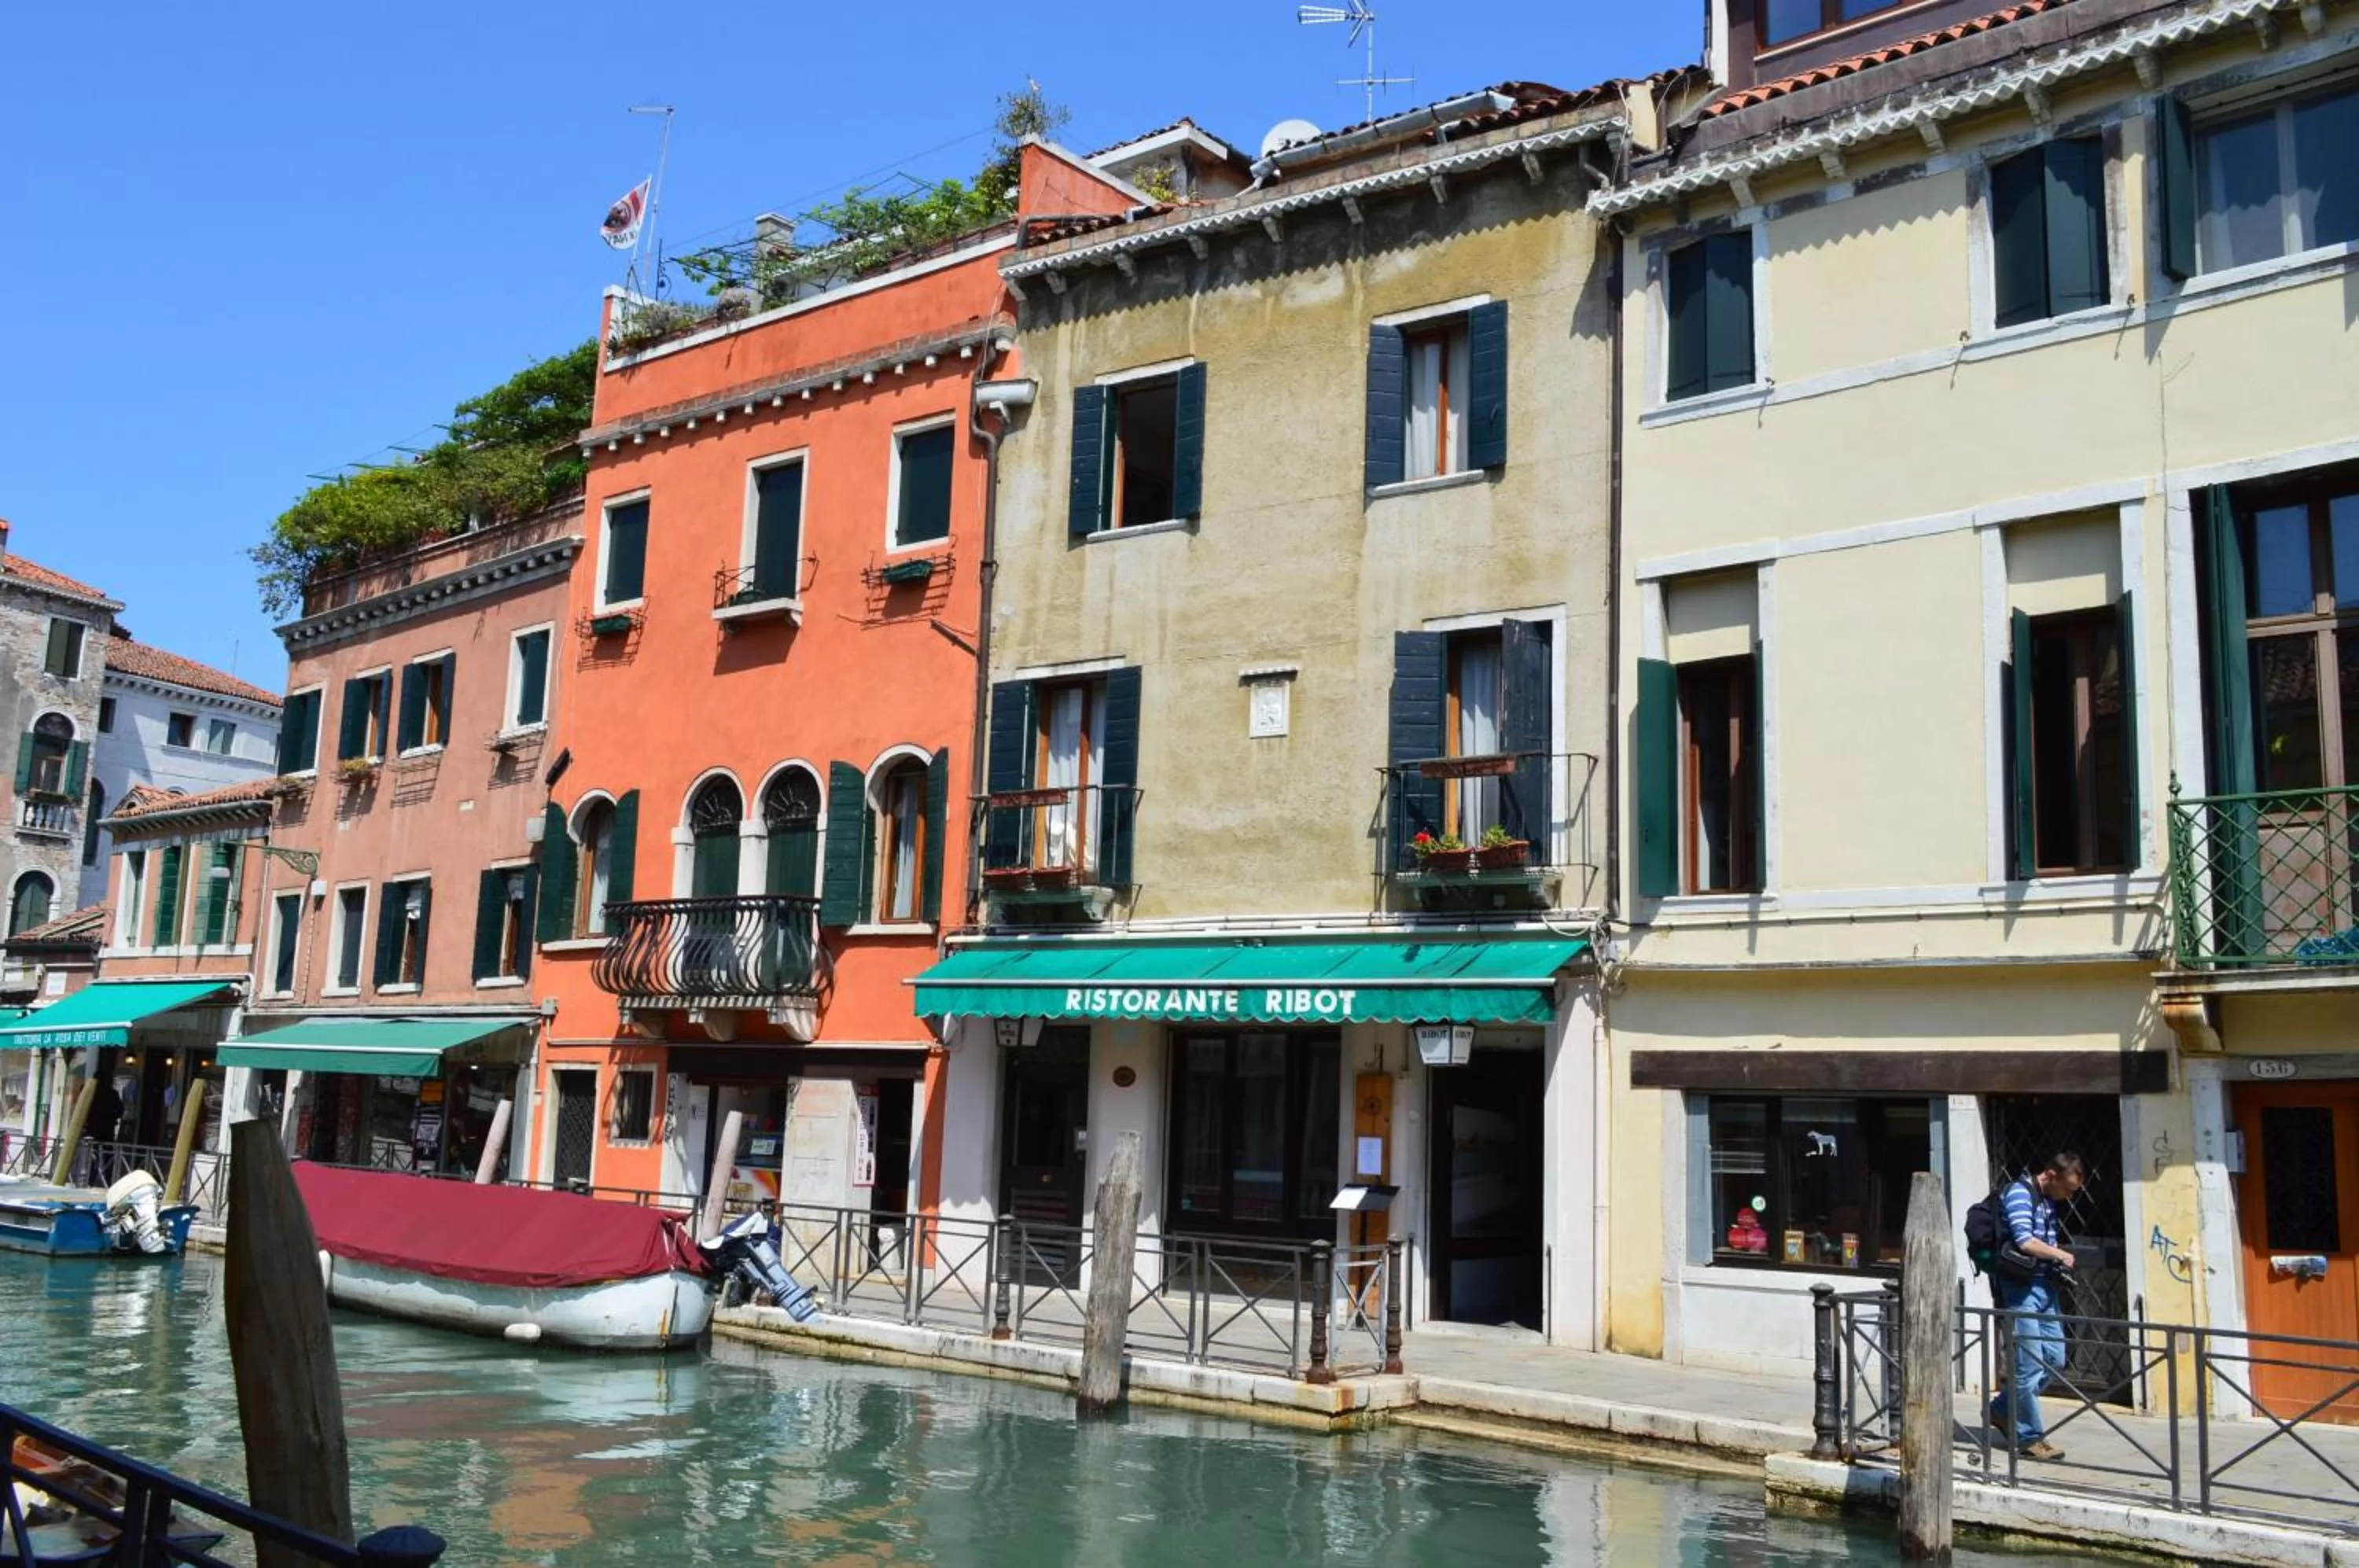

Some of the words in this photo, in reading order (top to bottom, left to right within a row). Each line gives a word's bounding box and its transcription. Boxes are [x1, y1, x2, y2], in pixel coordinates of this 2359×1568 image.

[1065, 988, 1239, 1013] RISTORANTE
[1264, 988, 1356, 1014] RIBOT
[1421, 1029, 1448, 1039] RIBOT
[2256, 1062, 2288, 1075] 156
